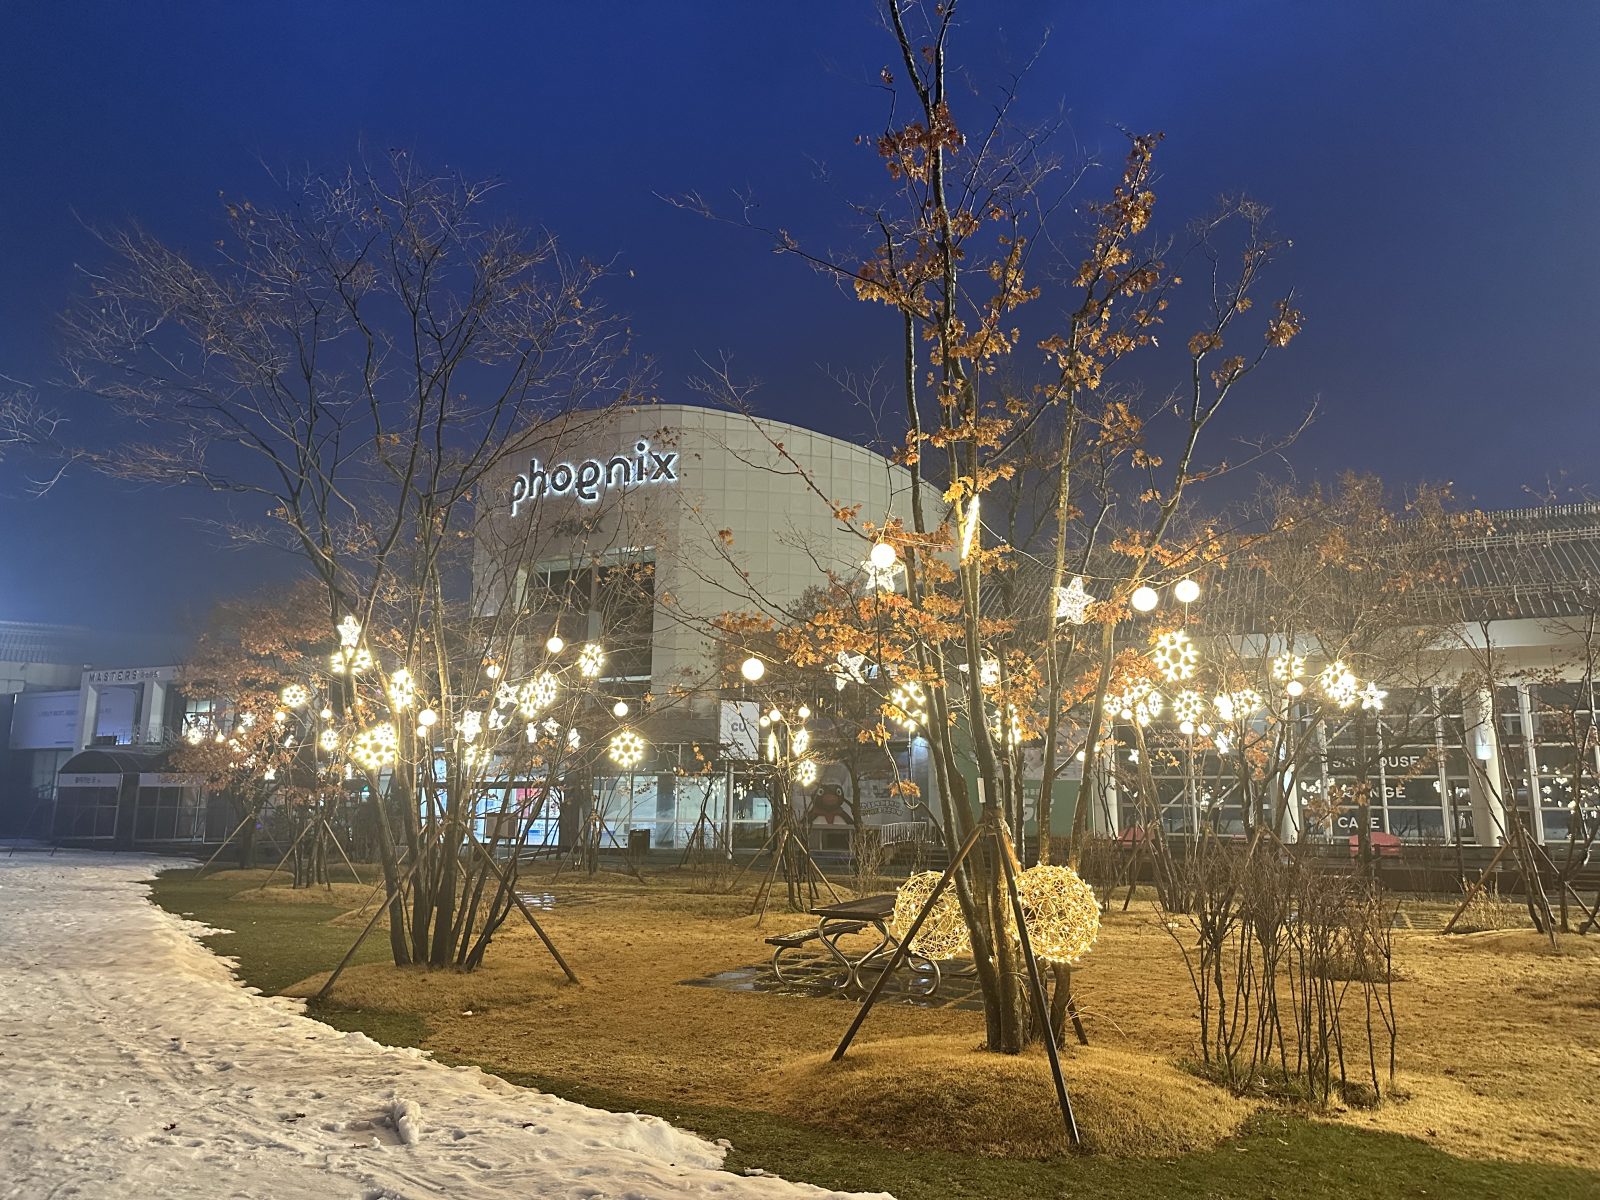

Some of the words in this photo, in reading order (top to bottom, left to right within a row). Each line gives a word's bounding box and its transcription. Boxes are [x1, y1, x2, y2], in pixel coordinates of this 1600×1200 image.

[511, 441, 677, 516] phoenix
[88, 670, 138, 682] MASTERS
[1338, 817, 1380, 829] CAE
